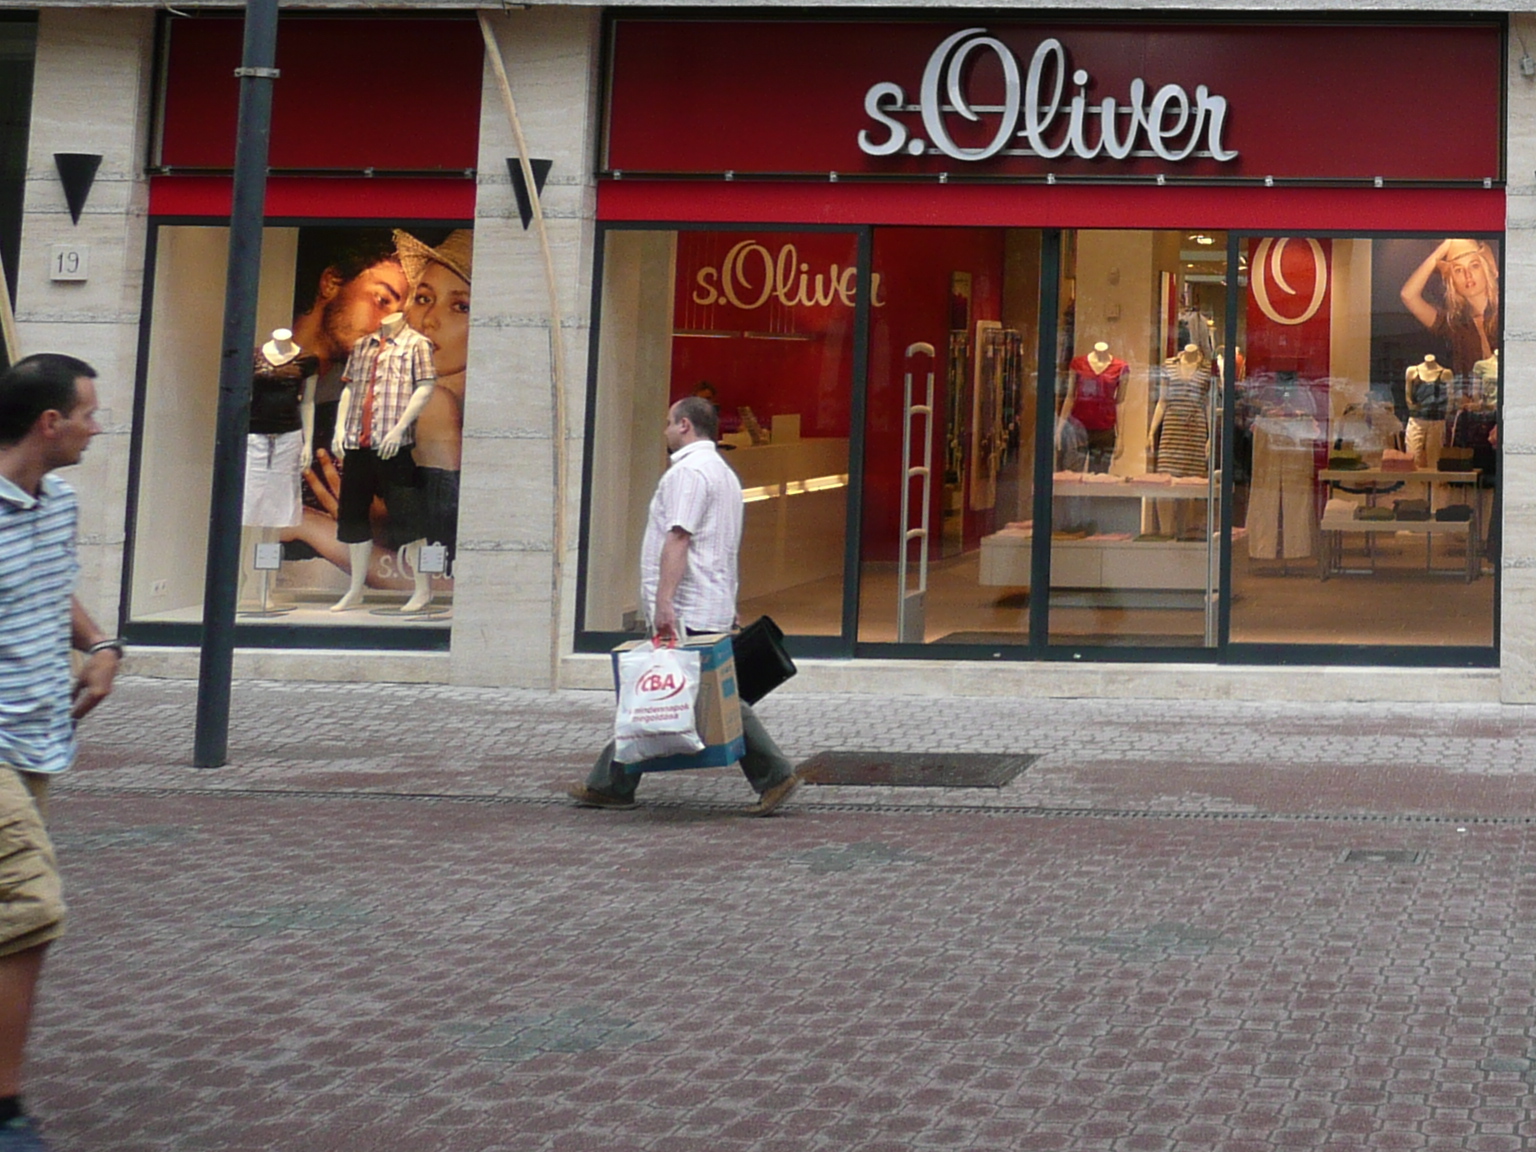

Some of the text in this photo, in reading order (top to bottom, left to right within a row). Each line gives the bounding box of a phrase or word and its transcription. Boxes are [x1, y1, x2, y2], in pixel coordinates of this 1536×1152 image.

[858, 28, 1239, 161] s.Oliver
[57, 251, 79, 273] 19
[641, 673, 676, 692] CBA
